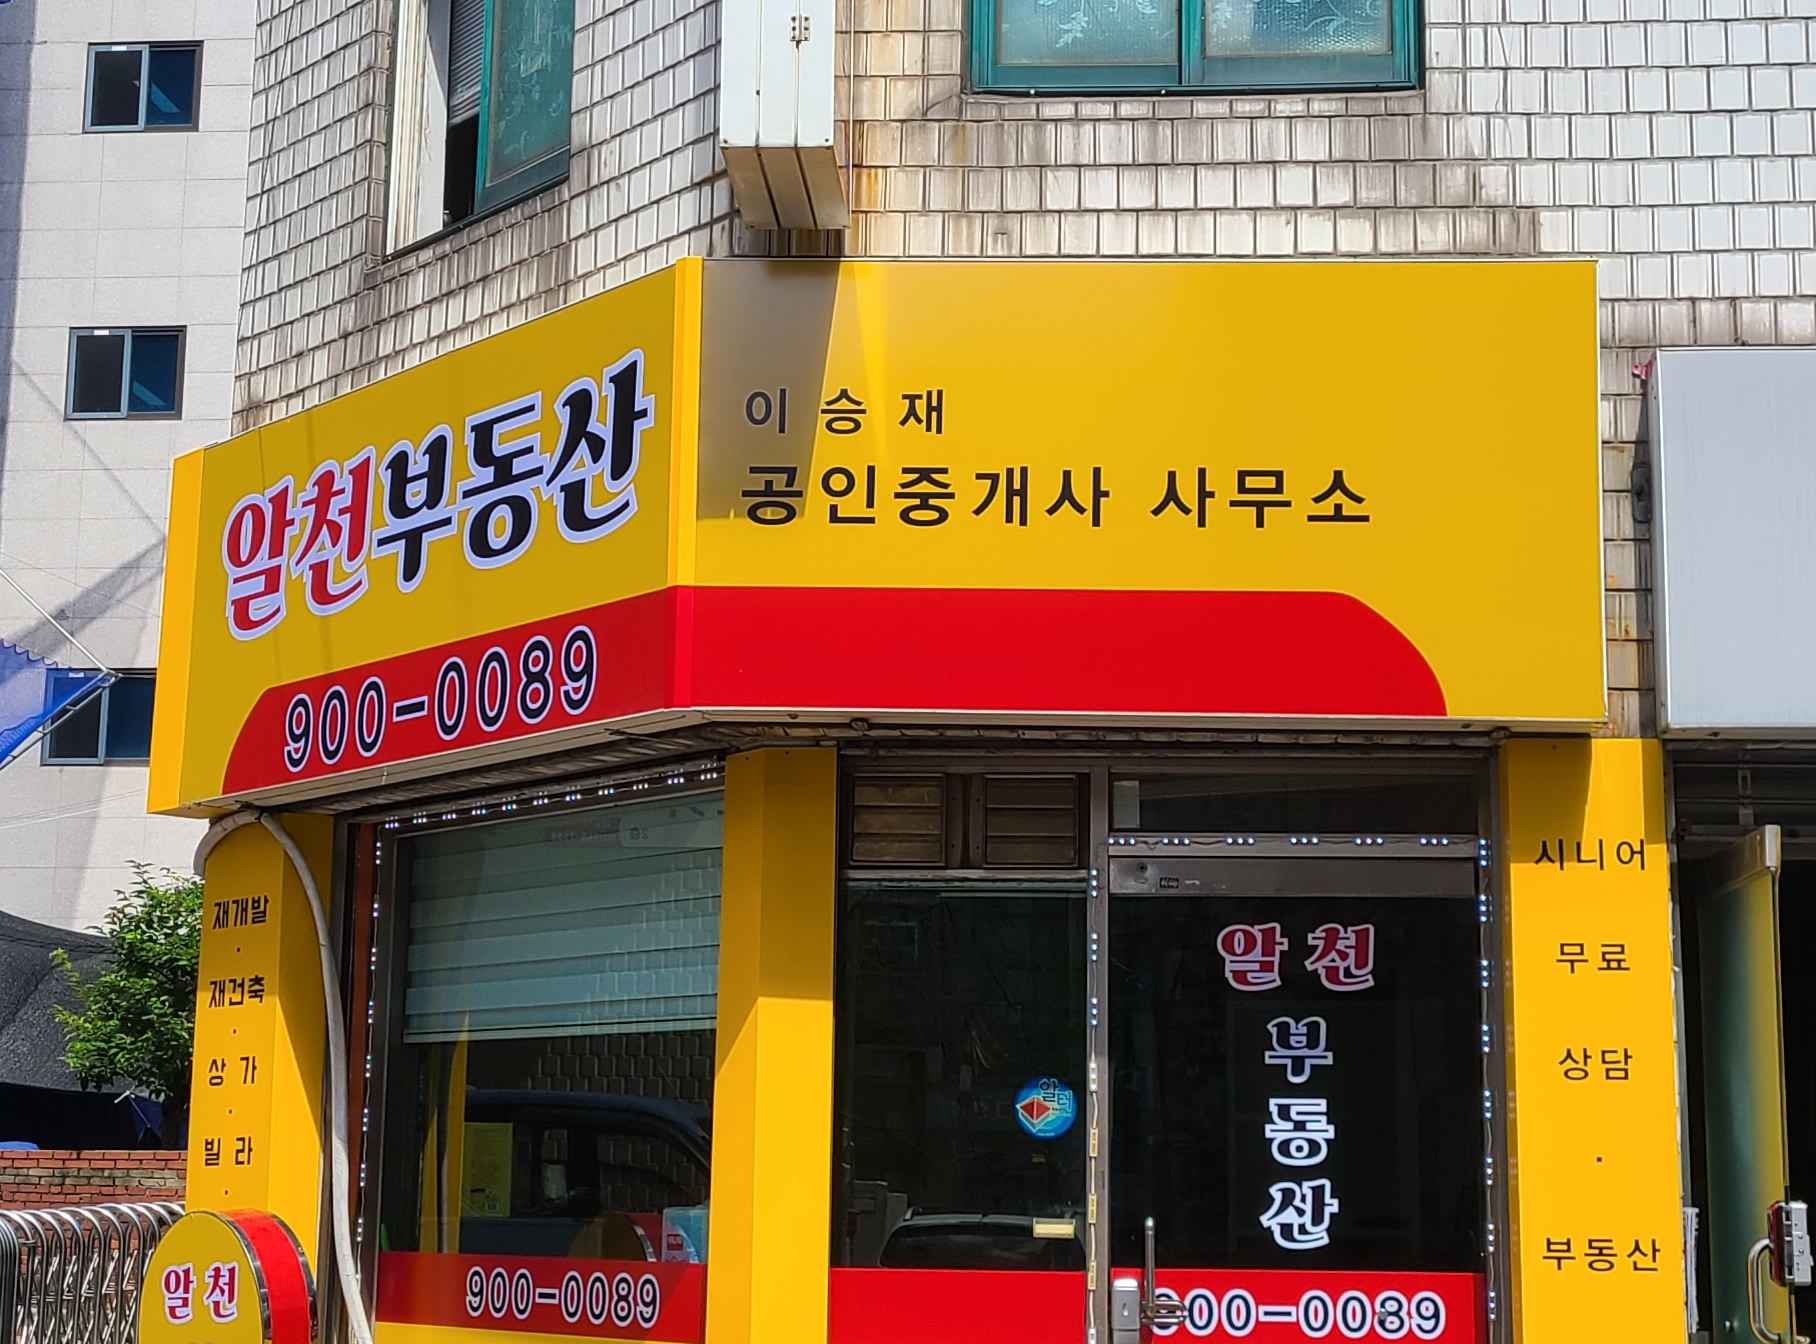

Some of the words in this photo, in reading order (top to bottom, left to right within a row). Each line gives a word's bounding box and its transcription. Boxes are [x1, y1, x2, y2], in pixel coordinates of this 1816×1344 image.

[221, 348, 655, 641] 알천부동산
[740, 463, 1111, 528] 공인중개사
[1148, 465, 1372, 530] 사무소
[284, 624, 598, 773] 900-0089
[1534, 837, 1646, 871] 시니어
[212, 893, 270, 931] 재개발
[1216, 921, 1375, 992] 알천
[1555, 942, 1631, 974] 무료
[208, 974, 265, 1009] 재건축
[208, 1054, 258, 1087] 상가
[1558, 1047, 1633, 1081] 상담
[203, 1136, 253, 1167] 빌라
[1259, 1015, 1339, 1251] 부동산
[1541, 1237, 1661, 1272] 부동산
[161, 1260, 239, 1325] 알천
[466, 1264, 661, 1329] 900-0089
